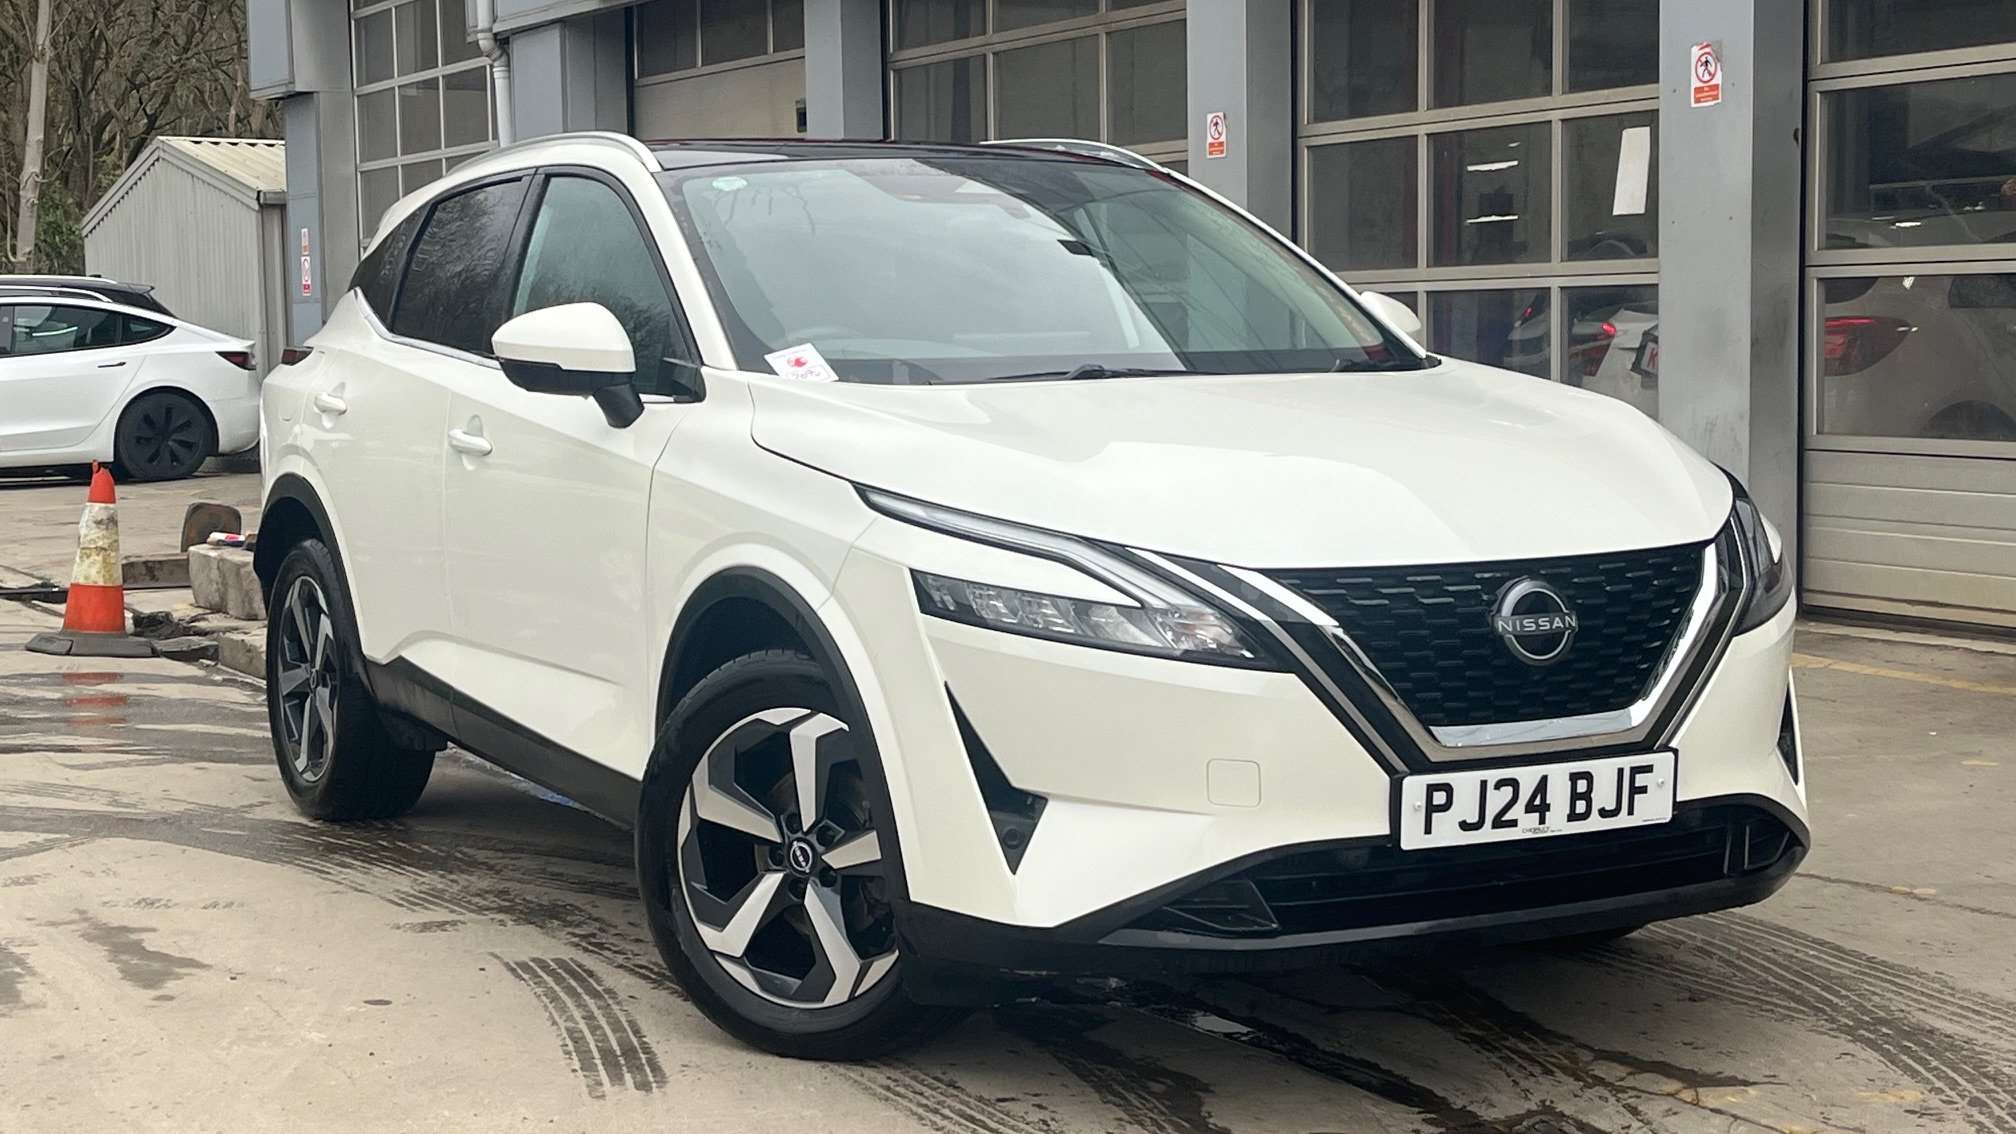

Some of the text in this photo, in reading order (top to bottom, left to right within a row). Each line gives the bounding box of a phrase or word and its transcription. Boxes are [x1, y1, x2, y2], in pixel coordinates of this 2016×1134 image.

[1498, 615, 1576, 632] NISSAN
[1423, 764, 1655, 835] PJ24 BJF
